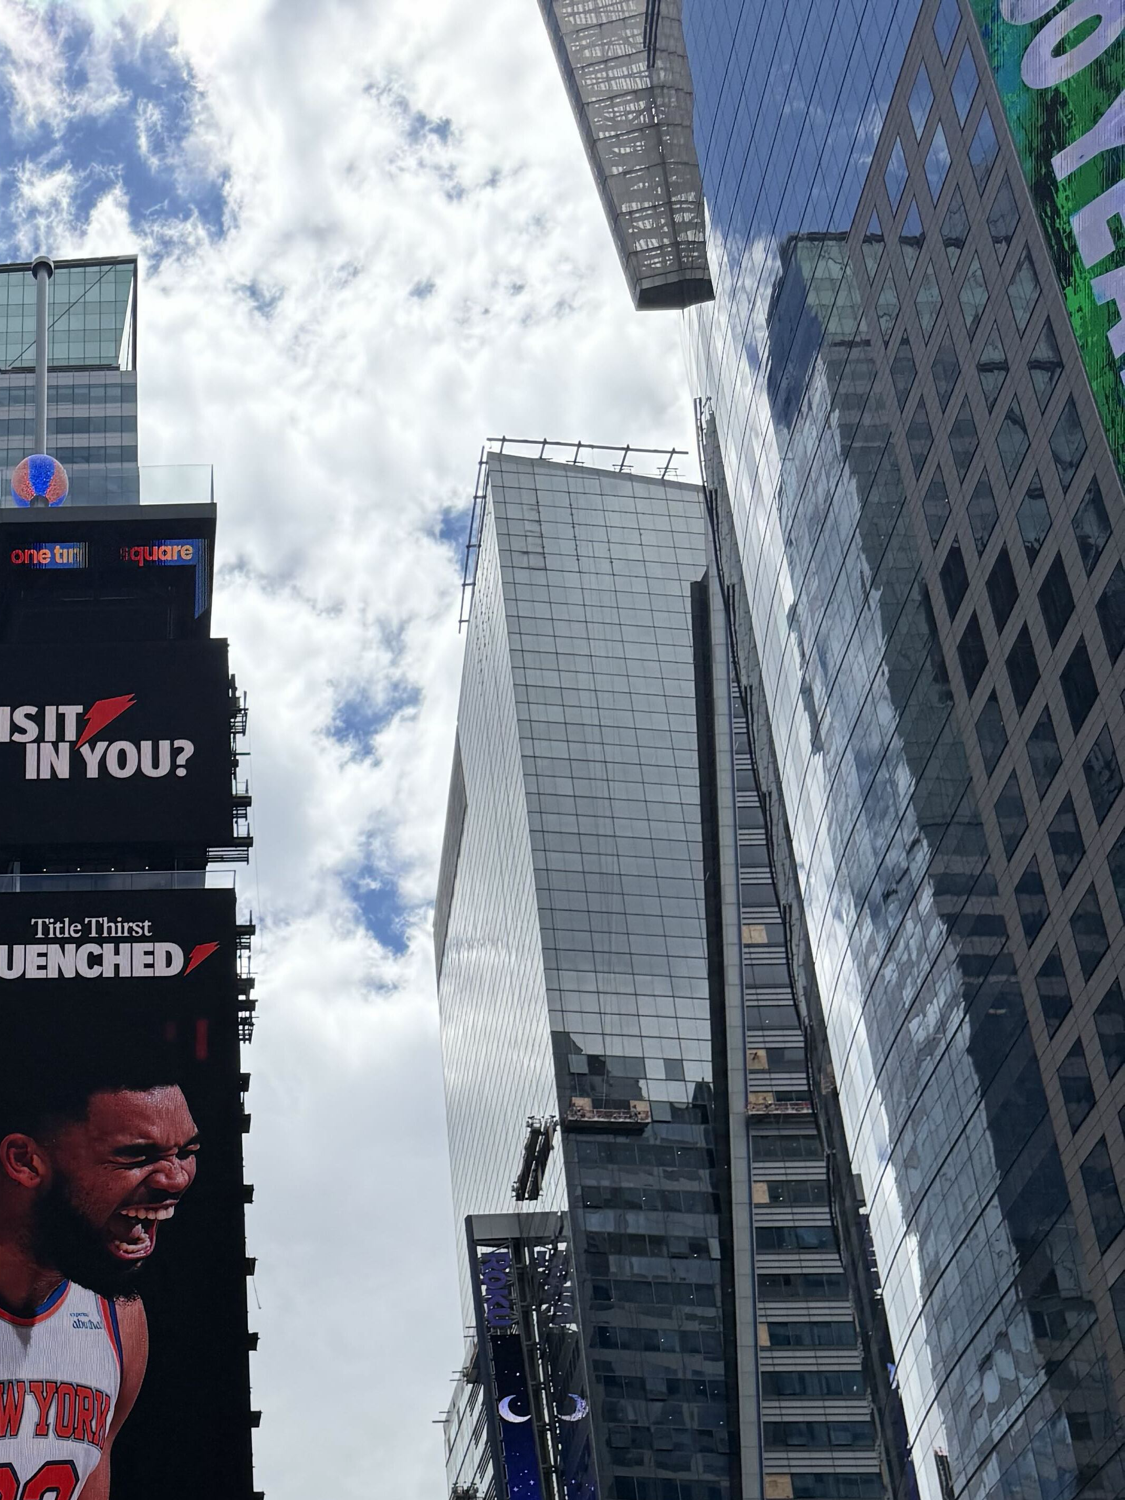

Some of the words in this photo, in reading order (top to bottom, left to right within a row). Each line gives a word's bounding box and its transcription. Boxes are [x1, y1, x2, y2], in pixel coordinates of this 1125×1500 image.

[10, 547, 51, 564] one
[44, 704, 83, 741] IT
[25, 742, 70, 780] IN
[78, 739, 195, 779] YOU?
[31, 917, 81, 938] Title
[84, 916, 153, 937] Thirst
[28, 1379, 112, 1453] YORK
